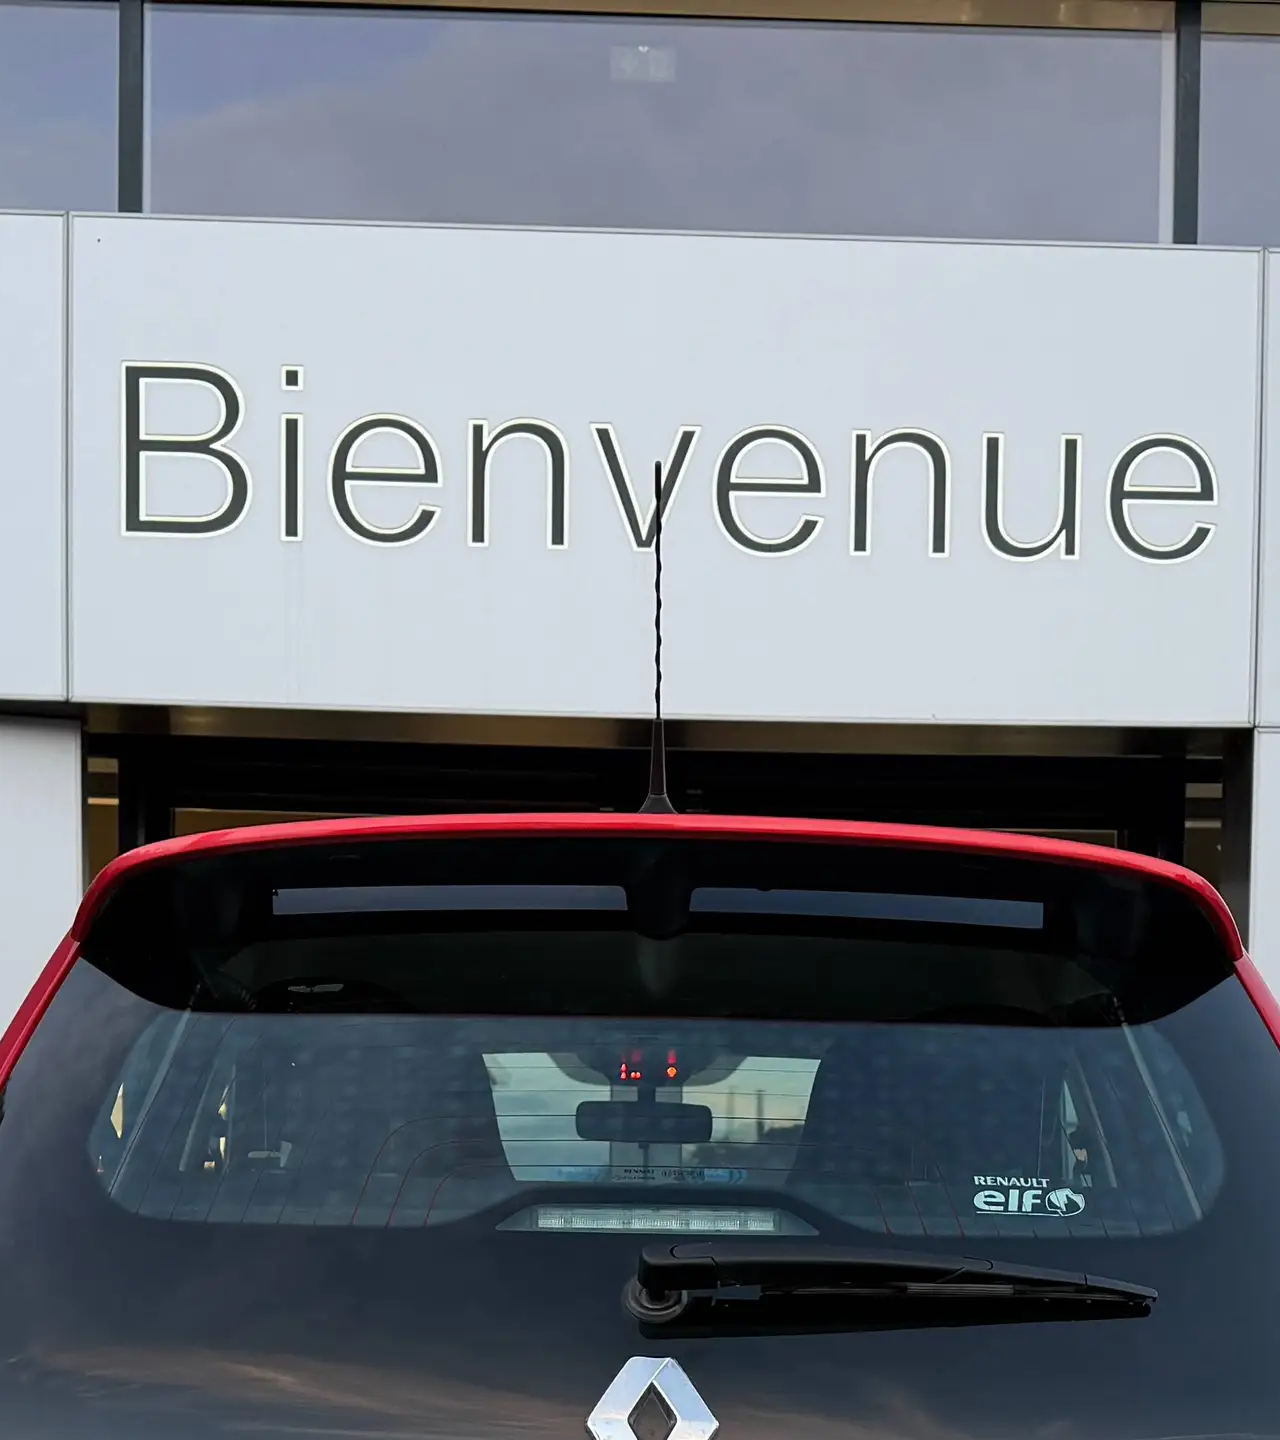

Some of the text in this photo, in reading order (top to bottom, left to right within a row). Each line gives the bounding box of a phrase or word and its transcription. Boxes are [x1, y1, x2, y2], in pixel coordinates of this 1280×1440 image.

[122, 361, 1218, 562] Bienvenue
[973, 1175, 1050, 1188] RENAULT
[973, 1189, 1043, 1212] elf
